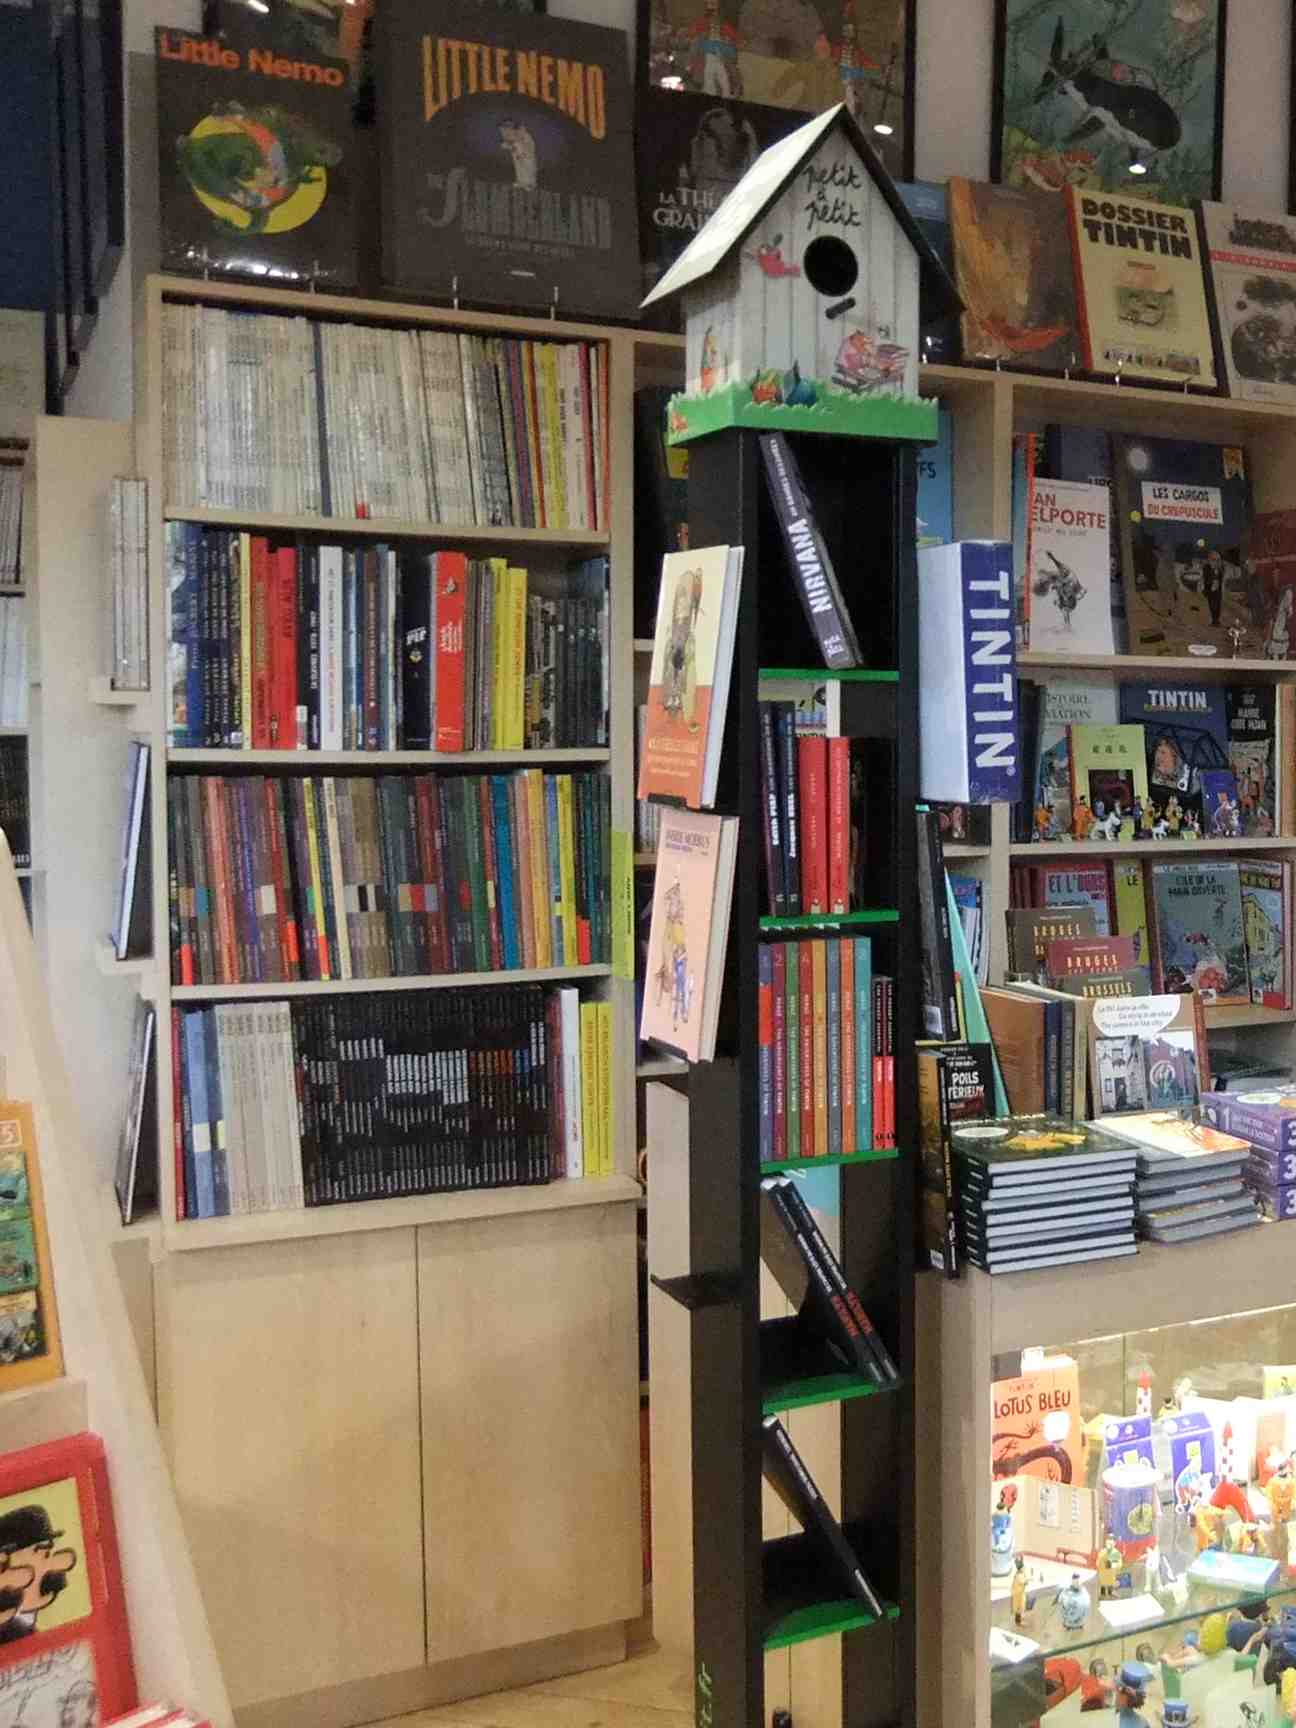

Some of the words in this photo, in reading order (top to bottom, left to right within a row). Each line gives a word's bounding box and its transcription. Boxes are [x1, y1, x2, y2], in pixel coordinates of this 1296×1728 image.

[160, 32, 241, 69] Little
[248, 48, 344, 86] Nemo
[422, 35, 511, 122] LITTLE
[517, 50, 606, 140] NEMO
[803, 164, 862, 191] petit
[804, 201, 861, 230] petit
[1081, 196, 1188, 234] DOSSIER
[1083, 218, 1192, 260] TINTIN
[787, 518, 832, 614] NIRVANA
[969, 570, 1016, 769] TINTIN
[1147, 689, 1207, 708] TINTIN
[993, 1395, 1033, 1419] LOTUS
[1038, 1389, 1071, 1410] BLEU
